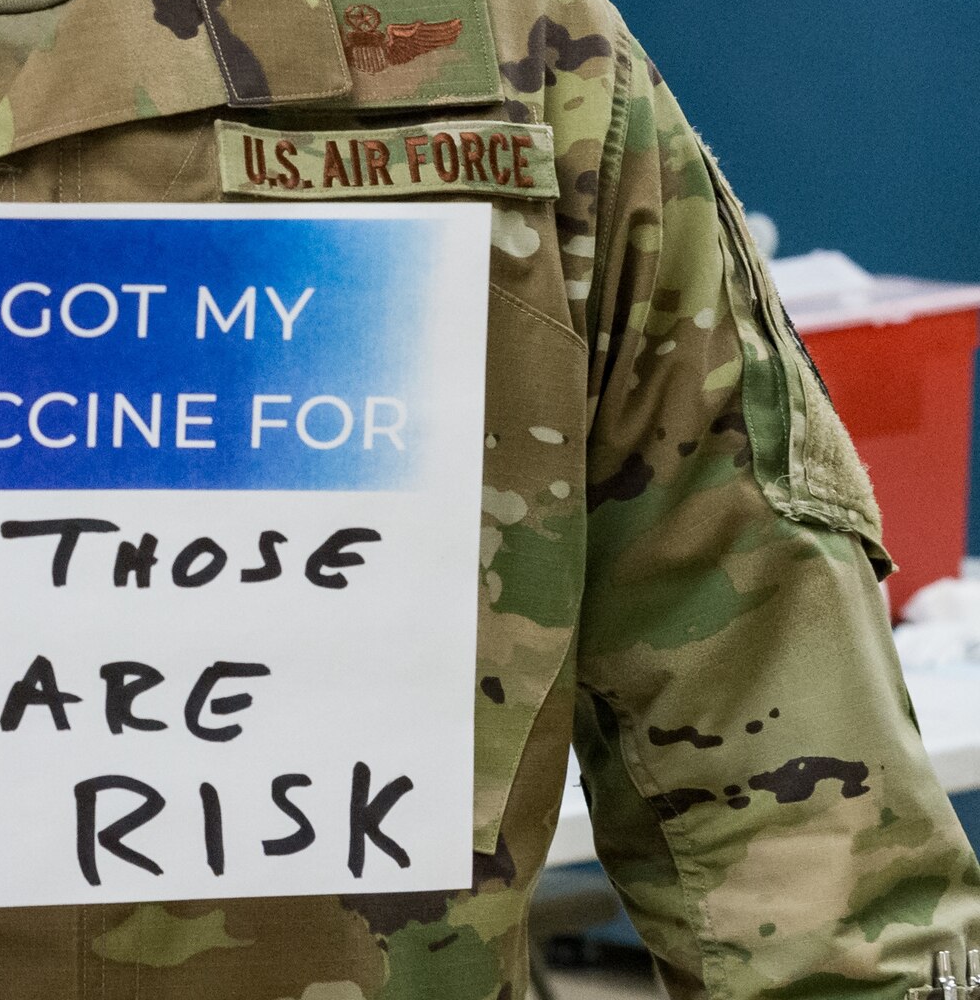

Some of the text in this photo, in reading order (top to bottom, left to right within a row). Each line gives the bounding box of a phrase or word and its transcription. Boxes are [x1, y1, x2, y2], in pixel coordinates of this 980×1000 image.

[242, 131, 536, 190] U.S. AIR FORCE
[0, 281, 168, 339] GOT
[195, 286, 316, 341] MY
[251, 394, 409, 451] FOR
[0, 518, 382, 595] THOSE
[0, 655, 271, 743] ARE
[73, 761, 414, 887] RISK
